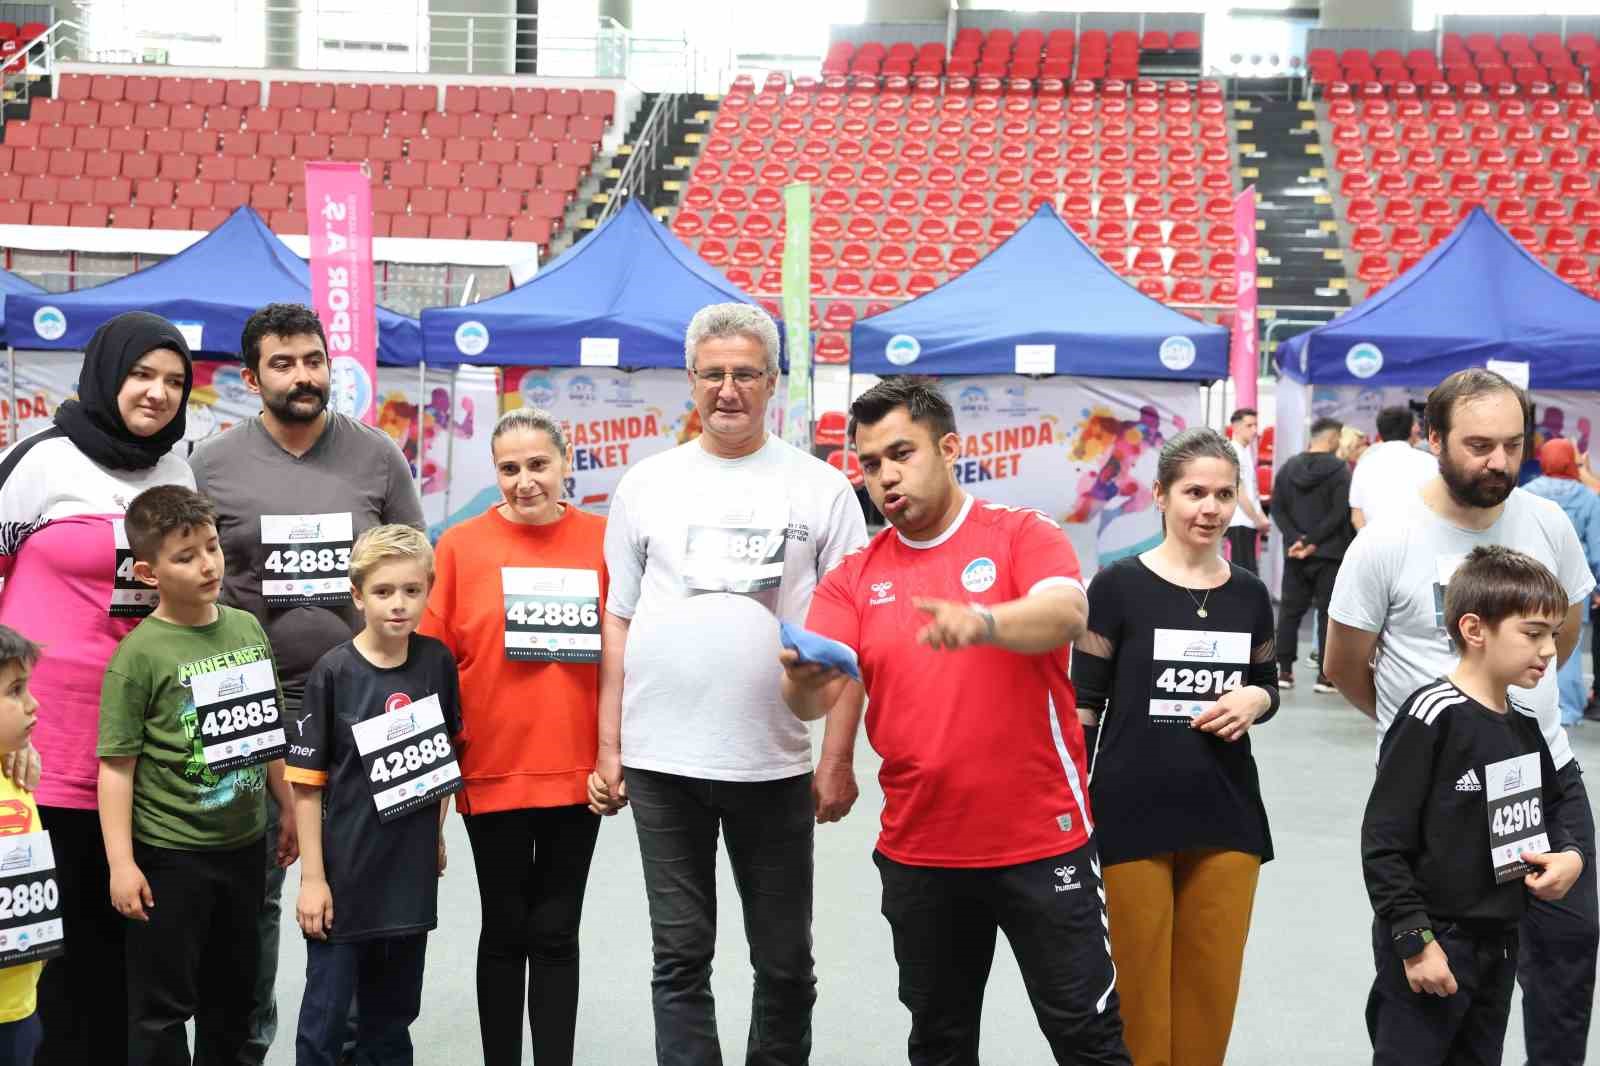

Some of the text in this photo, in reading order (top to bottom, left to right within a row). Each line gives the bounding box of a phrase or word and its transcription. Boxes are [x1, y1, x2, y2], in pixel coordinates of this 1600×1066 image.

[960, 421, 1053, 457] ASINDA
[572, 443, 629, 472] EKET
[265, 547, 350, 573] 42883
[507, 601, 598, 627] 42886
[1156, 668, 1243, 694] 42914
[201, 697, 278, 737] 42885
[370, 732, 451, 783] 42888
[1492, 797, 1541, 837] 42916
[0, 879, 59, 920] 2880
